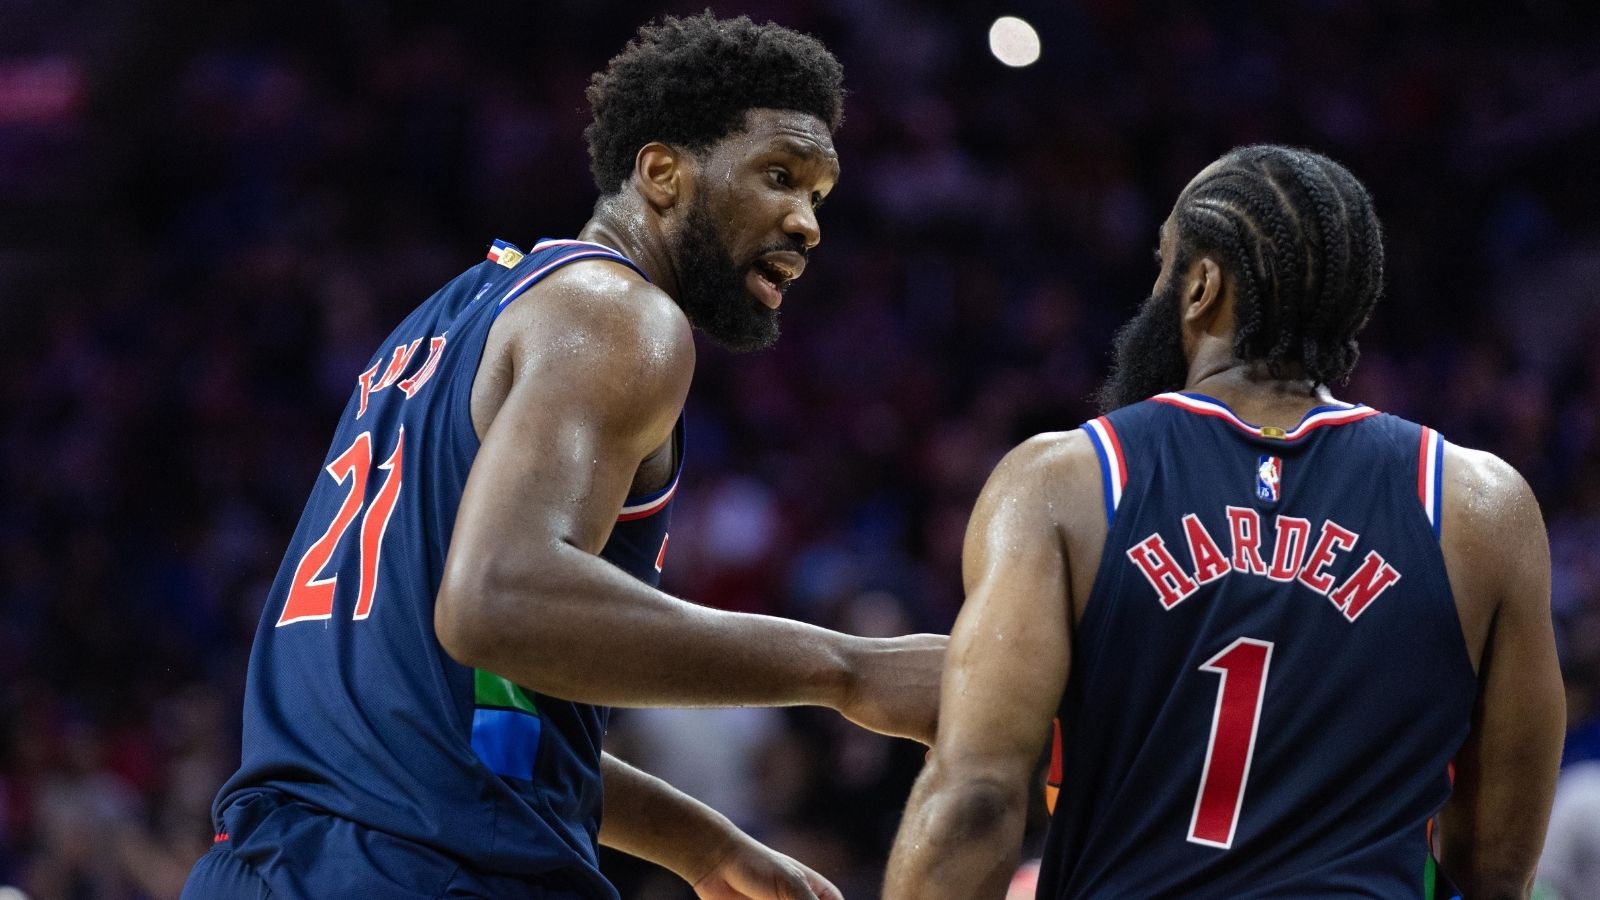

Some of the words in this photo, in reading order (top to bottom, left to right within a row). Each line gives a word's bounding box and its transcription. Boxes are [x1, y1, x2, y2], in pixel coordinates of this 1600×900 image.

[275, 423, 405, 628] 21
[1126, 505, 1402, 622] HARDEN
[1186, 636, 1275, 850] 1
